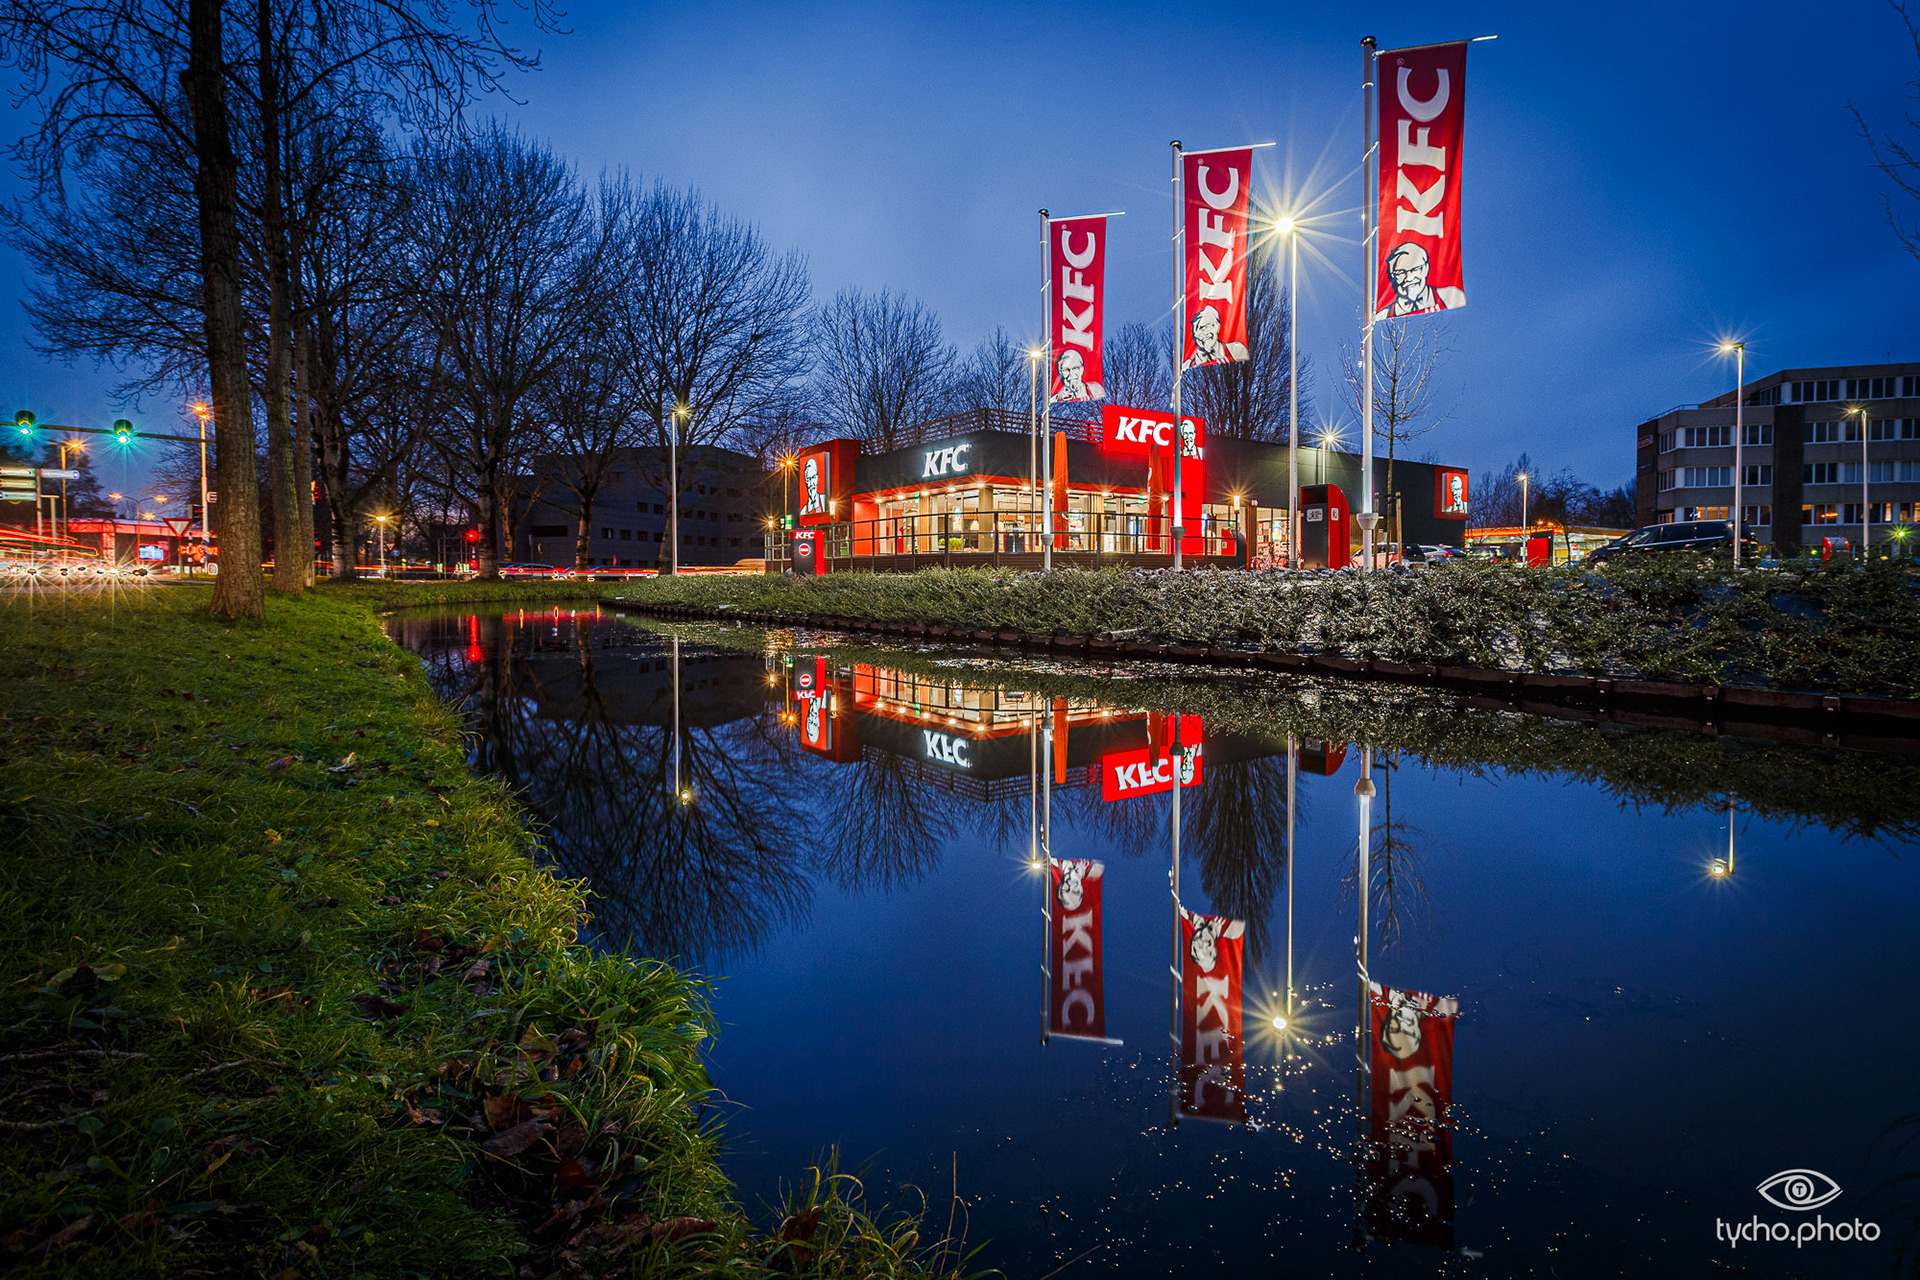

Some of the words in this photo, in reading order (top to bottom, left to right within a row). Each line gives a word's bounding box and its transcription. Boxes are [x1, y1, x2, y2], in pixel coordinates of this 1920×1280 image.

[1396, 67, 1450, 239] KFC
[1199, 165, 1239, 305] KFC
[1062, 229, 1096, 352] KFC
[922, 444, 969, 478] KFC
[1115, 416, 1171, 446] KFC
[795, 531, 815, 539] KFC
